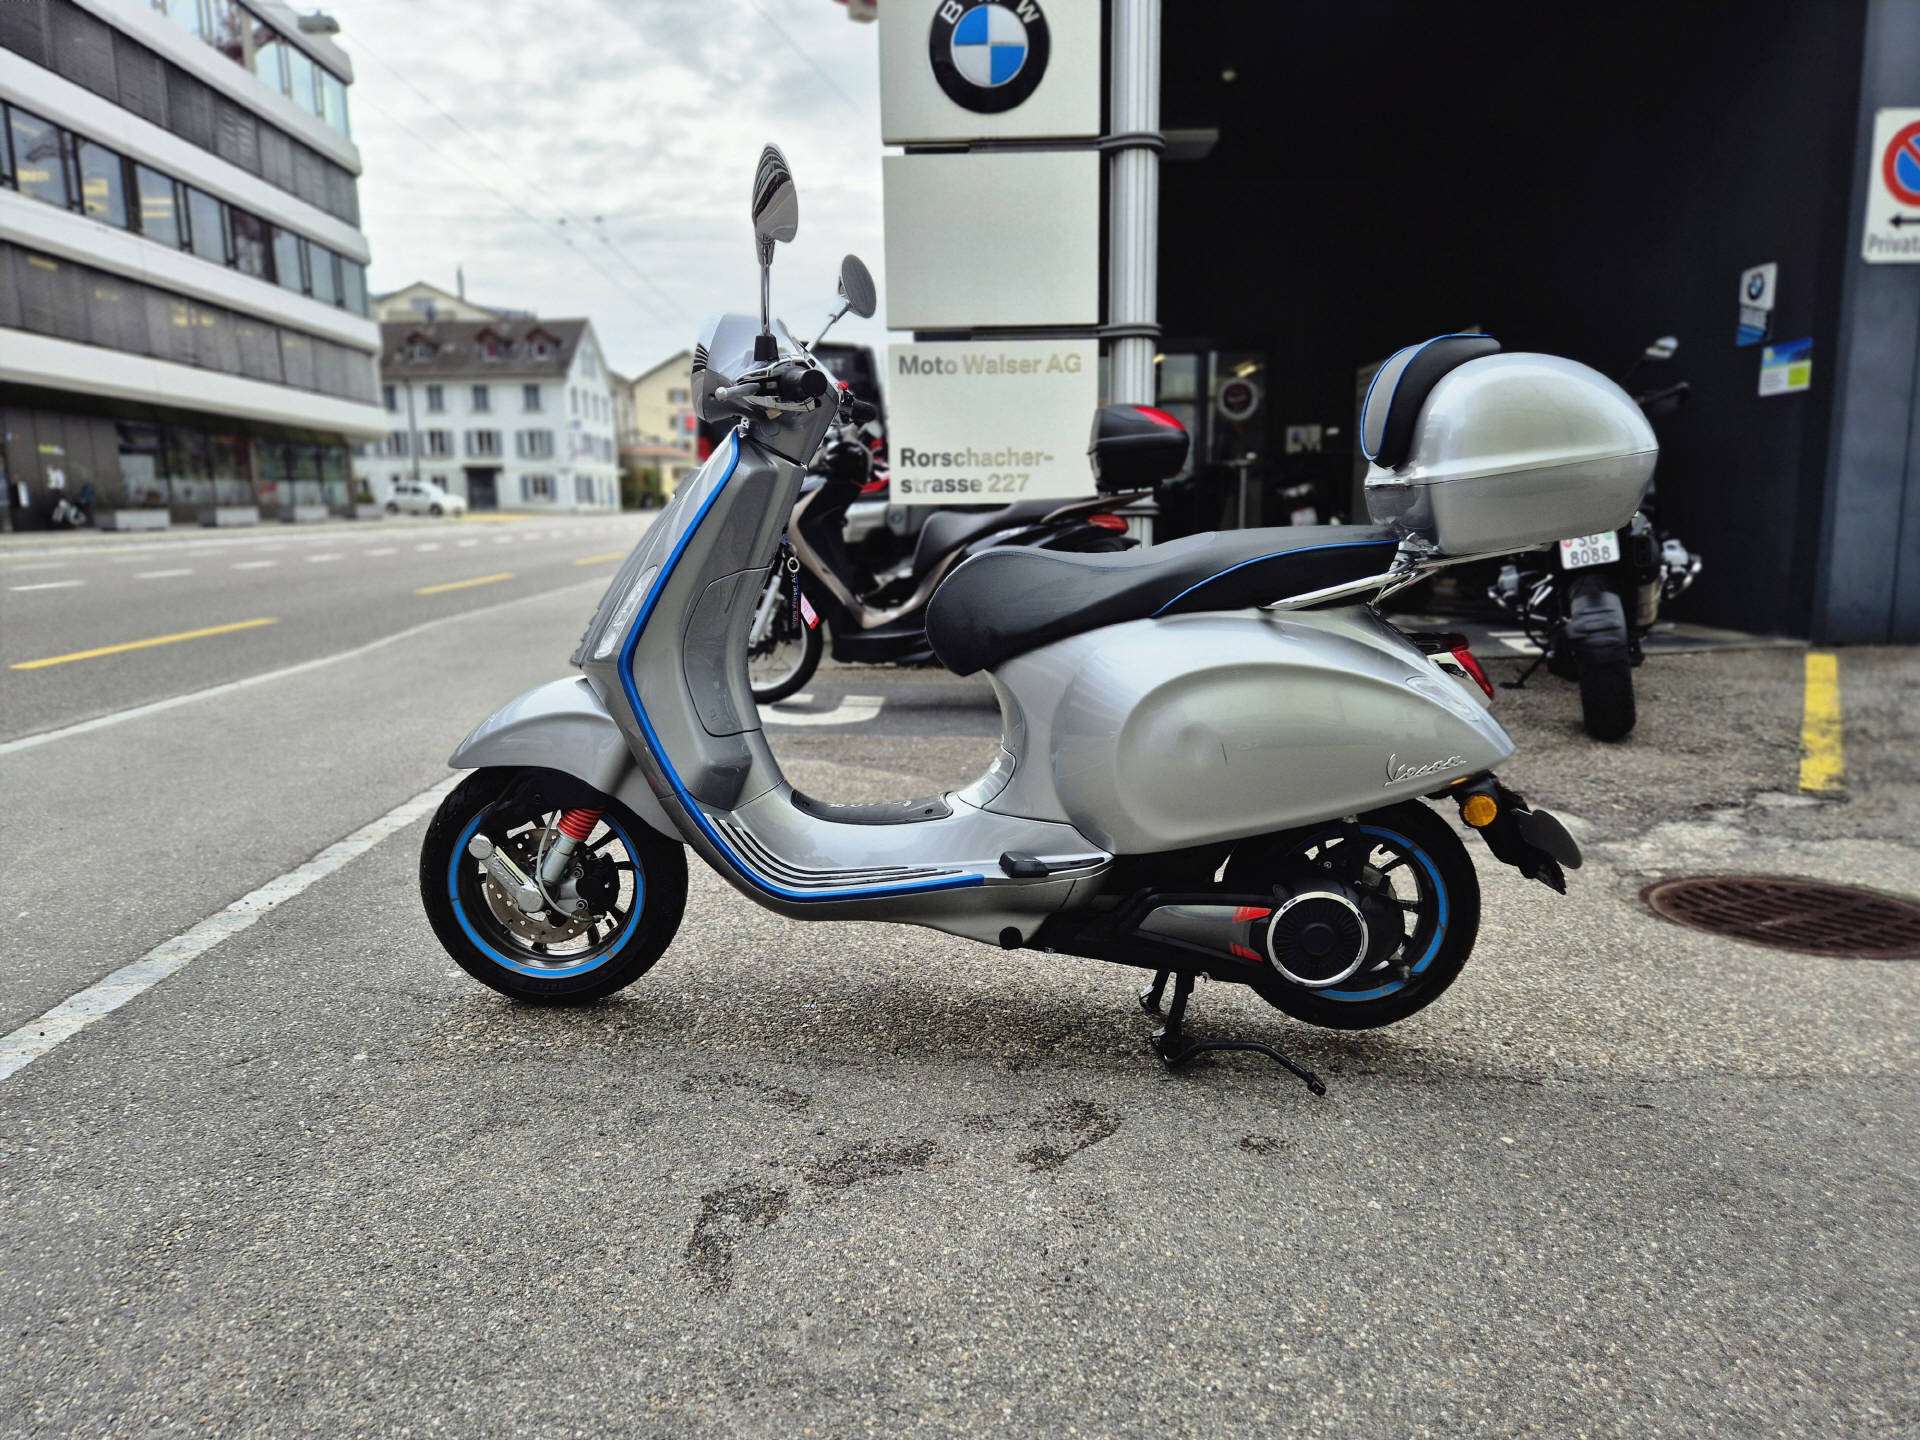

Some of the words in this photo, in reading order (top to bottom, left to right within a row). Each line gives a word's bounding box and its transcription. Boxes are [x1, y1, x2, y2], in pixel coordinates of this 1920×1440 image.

[940, 0, 1040, 24] BW
[899, 356, 958, 375] Moto
[962, 354, 1042, 375] Walser
[1046, 353, 1082, 373] AG
[900, 448, 1054, 467] Rorschacher-
[901, 477, 982, 494] strasse
[988, 474, 1030, 493] 227
[1570, 546, 1611, 566] 8088
